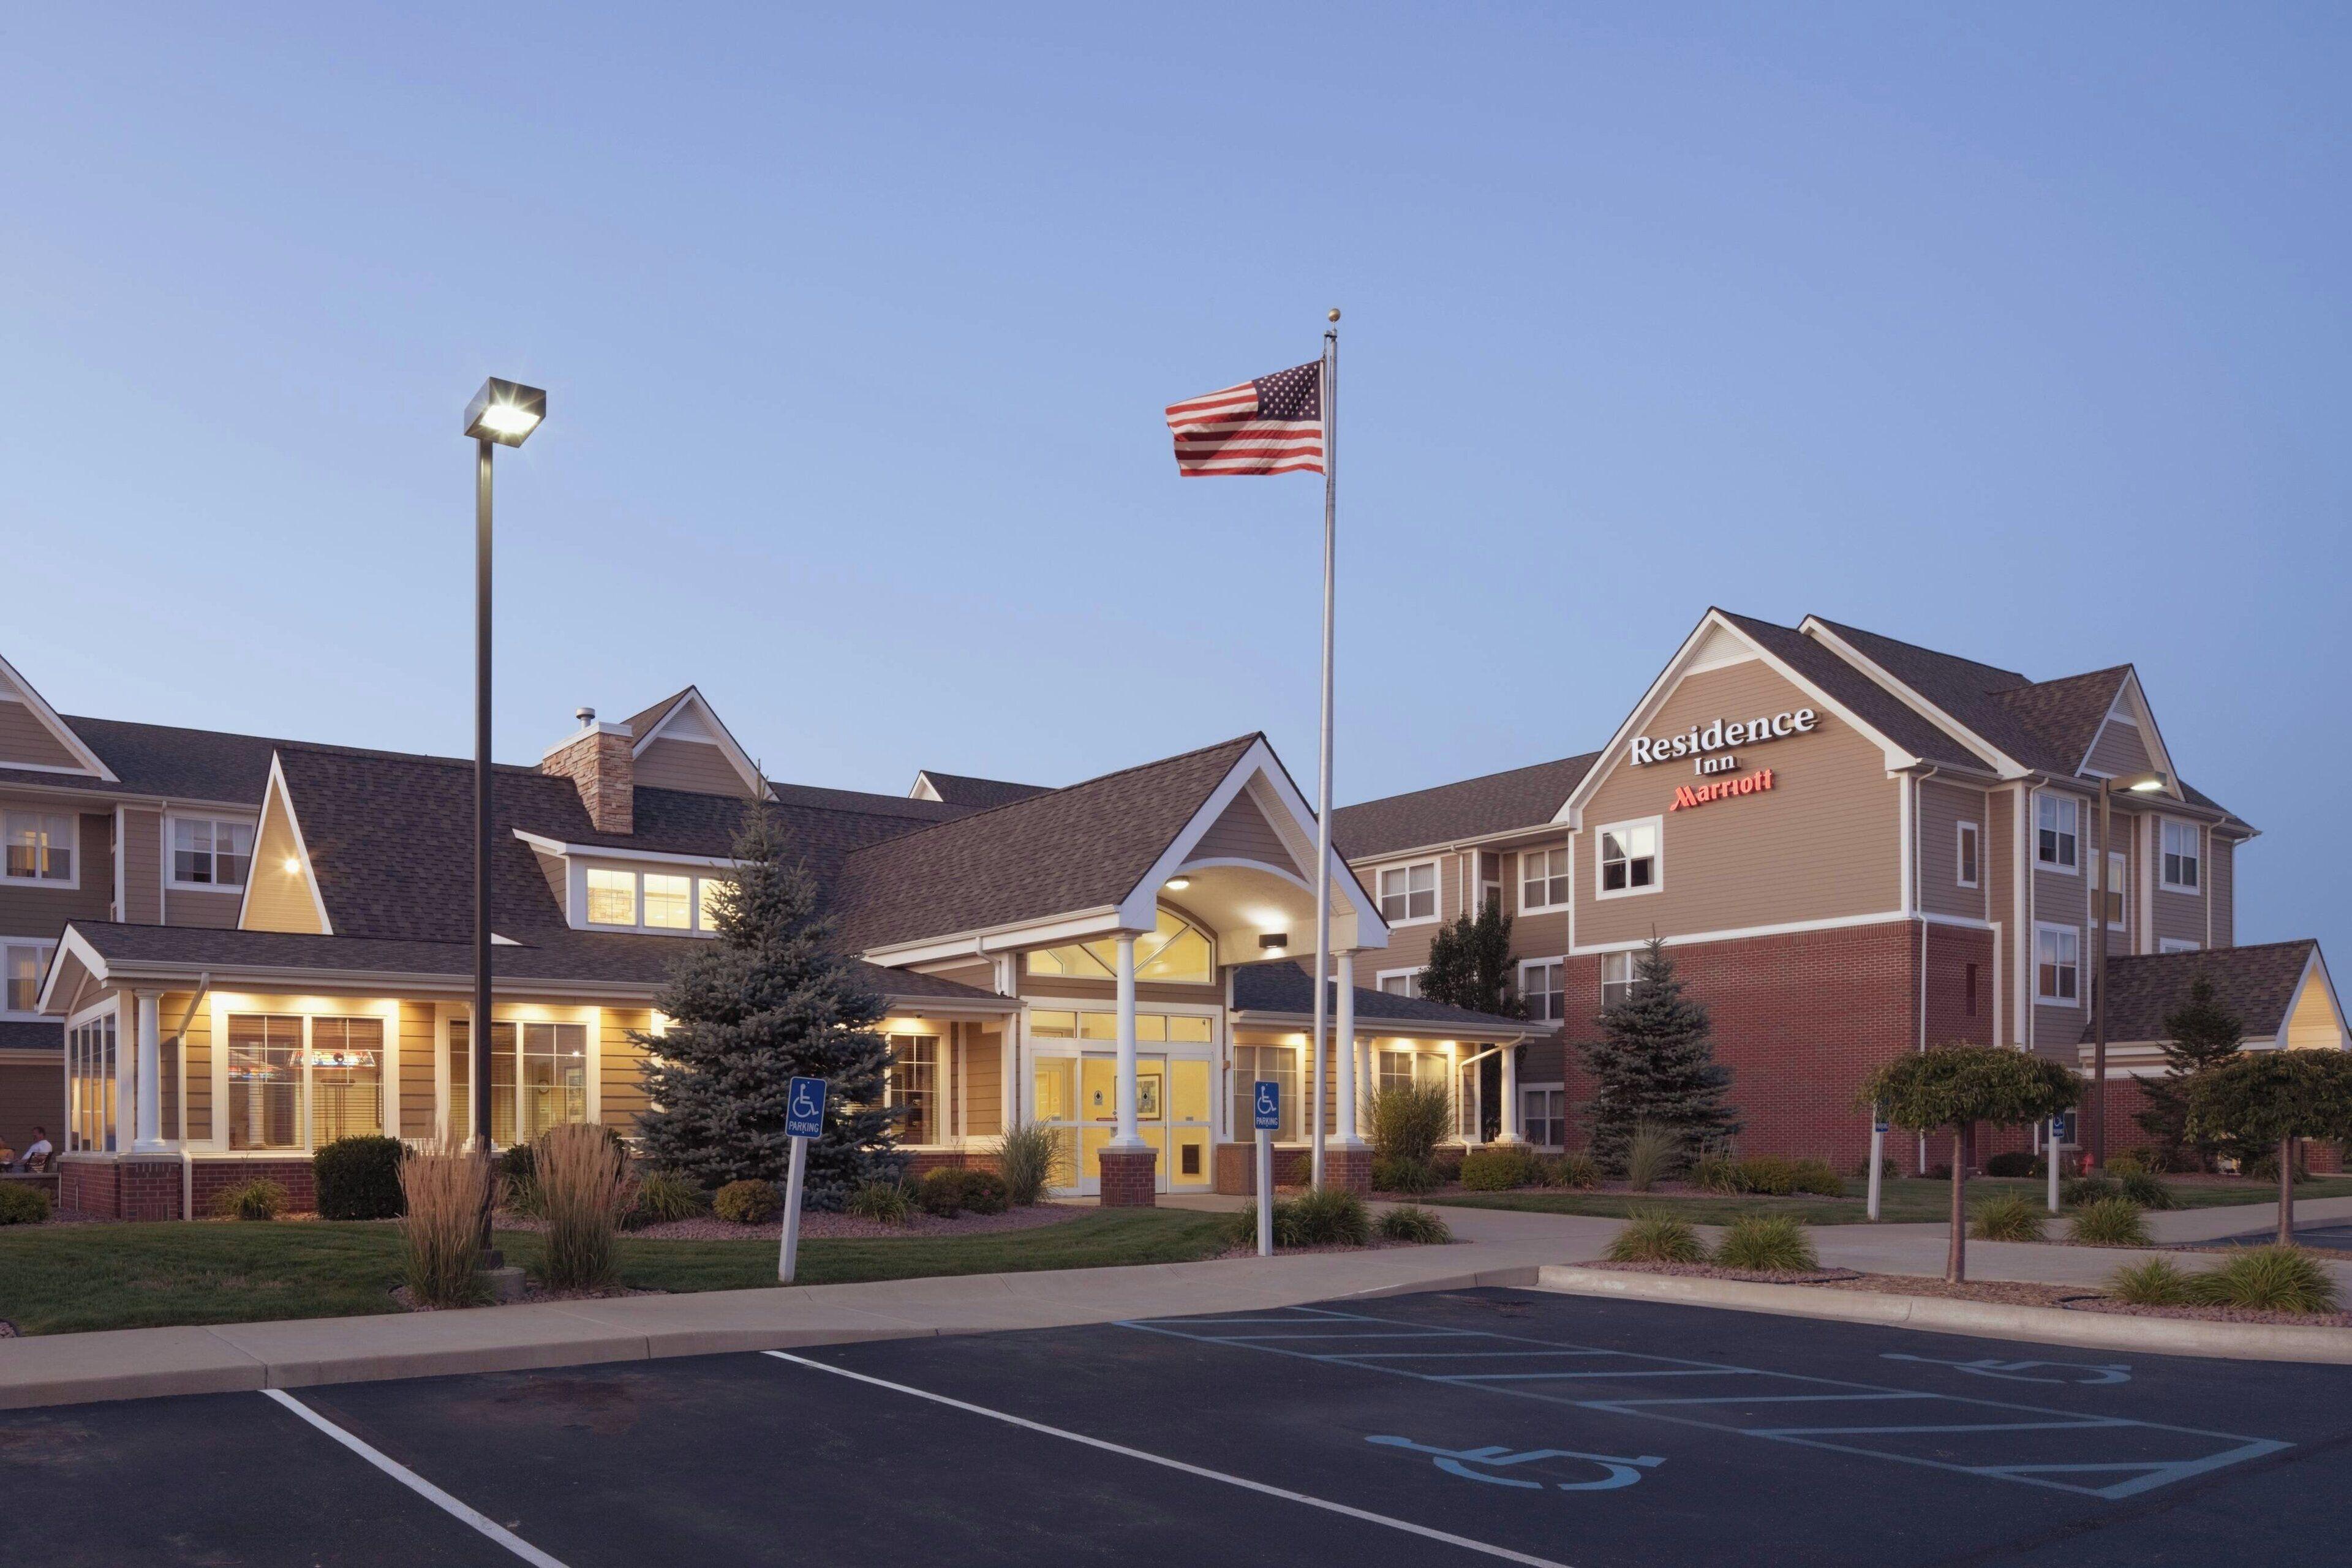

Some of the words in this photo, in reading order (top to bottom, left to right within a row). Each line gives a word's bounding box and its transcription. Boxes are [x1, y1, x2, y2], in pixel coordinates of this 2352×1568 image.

[1629, 708, 1817, 766] Residence
[1694, 755, 1736, 776] Inn
[1670, 769, 1774, 812] Marriott
[788, 1121, 820, 1133] PARKING
[1256, 1117, 1278, 1126] PARKING
